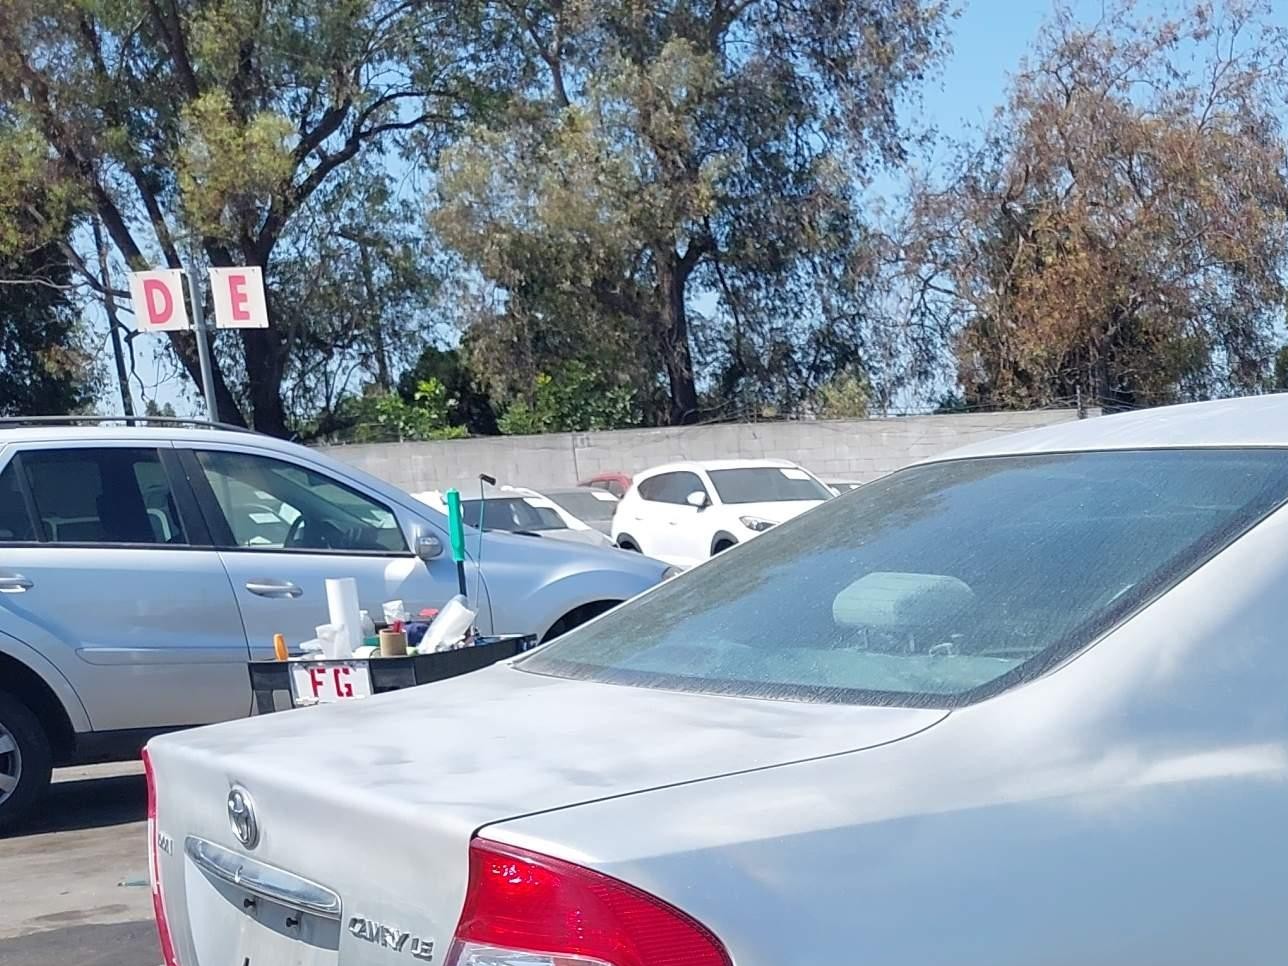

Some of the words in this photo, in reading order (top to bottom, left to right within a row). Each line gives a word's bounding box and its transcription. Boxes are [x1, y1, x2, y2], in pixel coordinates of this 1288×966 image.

[144, 279, 173, 323] D
[228, 275, 250, 320] E
[411, 937, 433, 961] LE
